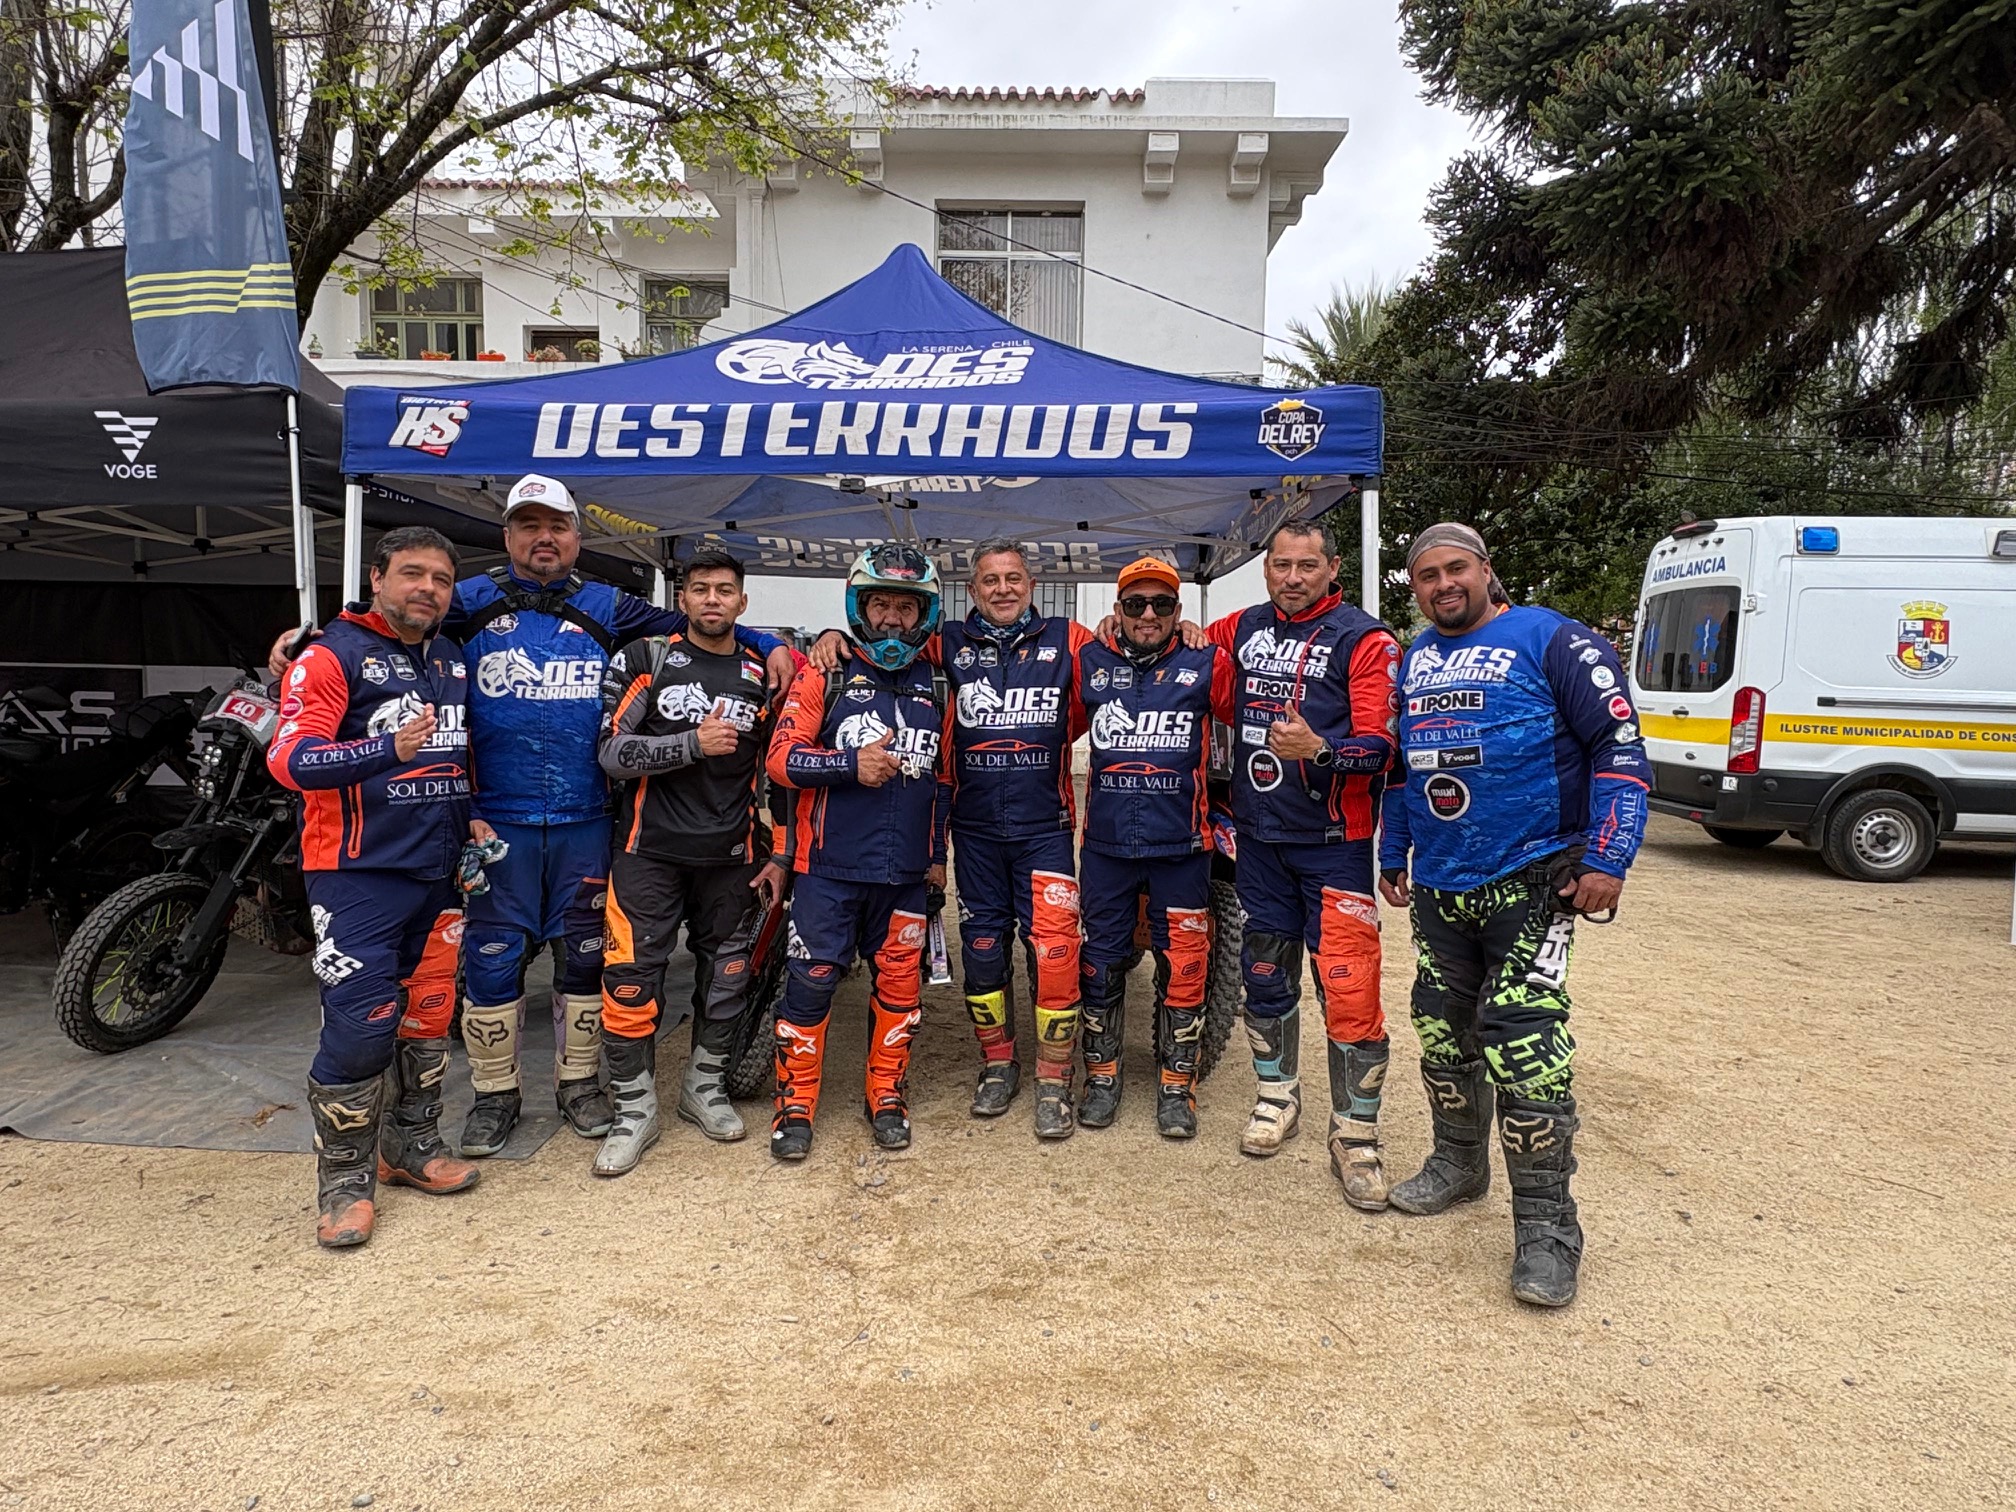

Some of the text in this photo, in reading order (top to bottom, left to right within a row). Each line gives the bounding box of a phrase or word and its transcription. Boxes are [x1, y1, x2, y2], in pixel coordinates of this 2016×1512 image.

[921, 345, 974, 353] SERENA
[992, 339, 1030, 348] CHILE
[871, 347, 1035, 379] DES
[808, 371, 1025, 390] TERRADOS
[388, 406, 470, 447] HS
[1278, 411, 1306, 424] COPA
[532, 400, 1199, 460] DESTERRADOS
[104, 464, 158, 479] VOGE
[1651, 556, 1726, 583] AMBULANCIA
[1442, 645, 1517, 674] DES
[543, 660, 603, 686] DES
[514, 685, 599, 700] TERRADOS
[1003, 687, 1060, 712] DES
[231, 701, 256, 718] 40
[1421, 692, 1482, 712] IPONE
[439, 705, 467, 731] DE
[977, 711, 1058, 725] TERRADOS
[1243, 707, 1256, 719] SOL
[1135, 711, 1194, 735] DES
[1780, 723, 1838, 735] ILUSTRE
[1842, 725, 1954, 740] MUNICIPALIDAD
[1959, 730, 1977, 741] DE
[895, 727, 940, 757] DES
[1111, 735, 1190, 748] TERRADOS
[1425, 730, 1443, 742] DEL
[298, 752, 319, 766] SOL
[322, 749, 347, 764] DEL
[651, 743, 684, 762] DES
[788, 753, 803, 766] SOL
[804, 755, 822, 768] DEL
[964, 752, 1050, 767] SOL DEL VALLE
[1453, 753, 1476, 762] VOGE
[387, 782, 421, 798] SOL
[425, 780, 450, 796] DEL
[1100, 775, 1182, 789] SOL DEL VALLE
[1431, 785, 1456, 797] maxi
[1621, 791, 1638, 830] VALLE
